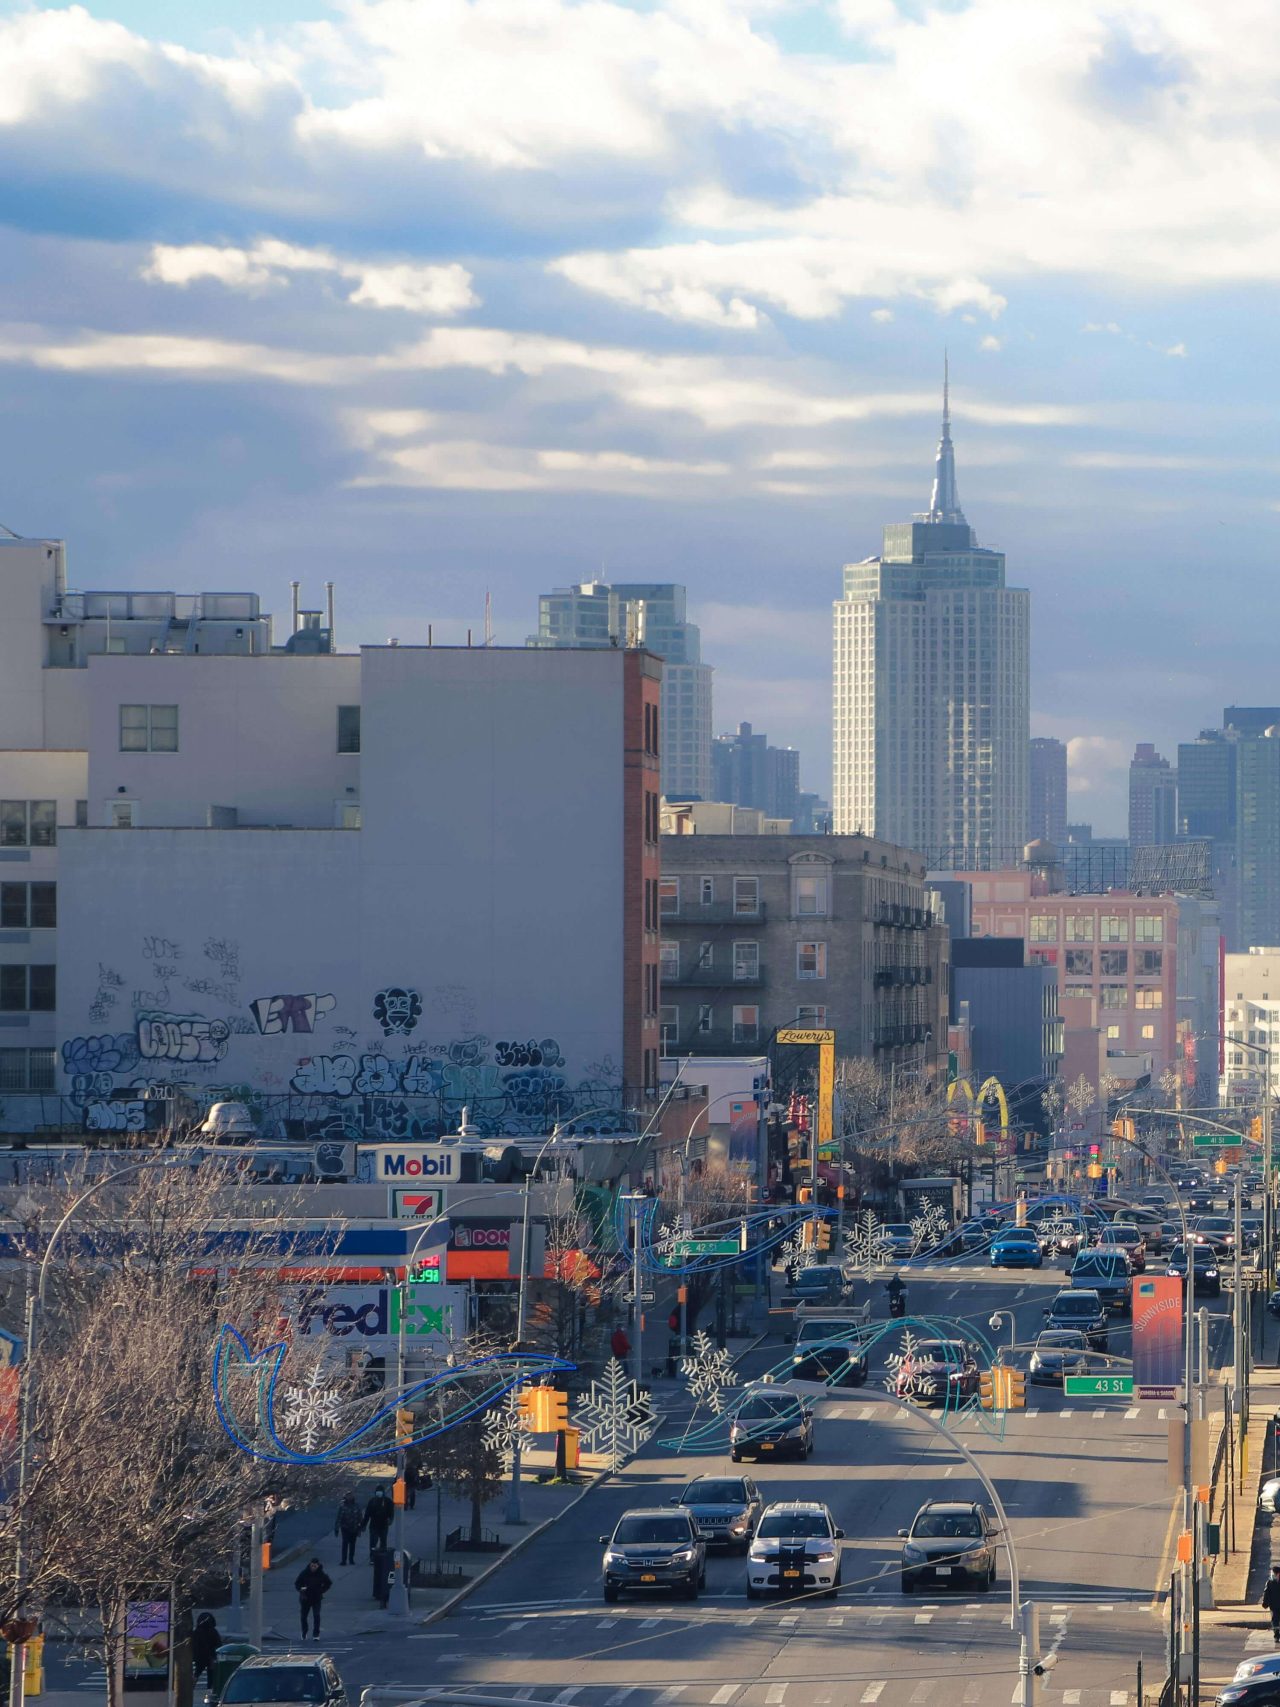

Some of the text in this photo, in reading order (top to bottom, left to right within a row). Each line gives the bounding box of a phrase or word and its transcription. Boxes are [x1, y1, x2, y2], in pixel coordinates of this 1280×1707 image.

[779, 1030, 833, 1043] Lowery's
[822, 1047, 831, 1085] WINE
[820, 1093, 832, 1159] FACTOY
[384, 1154, 452, 1176] Mobil
[403, 1195, 433, 1215] 7
[472, 1229, 510, 1246] DON
[695, 1243, 718, 1252] 42 St
[1134, 1296, 1181, 1332] SUNNYSIDE
[1095, 1380, 1124, 1392] 43 St
